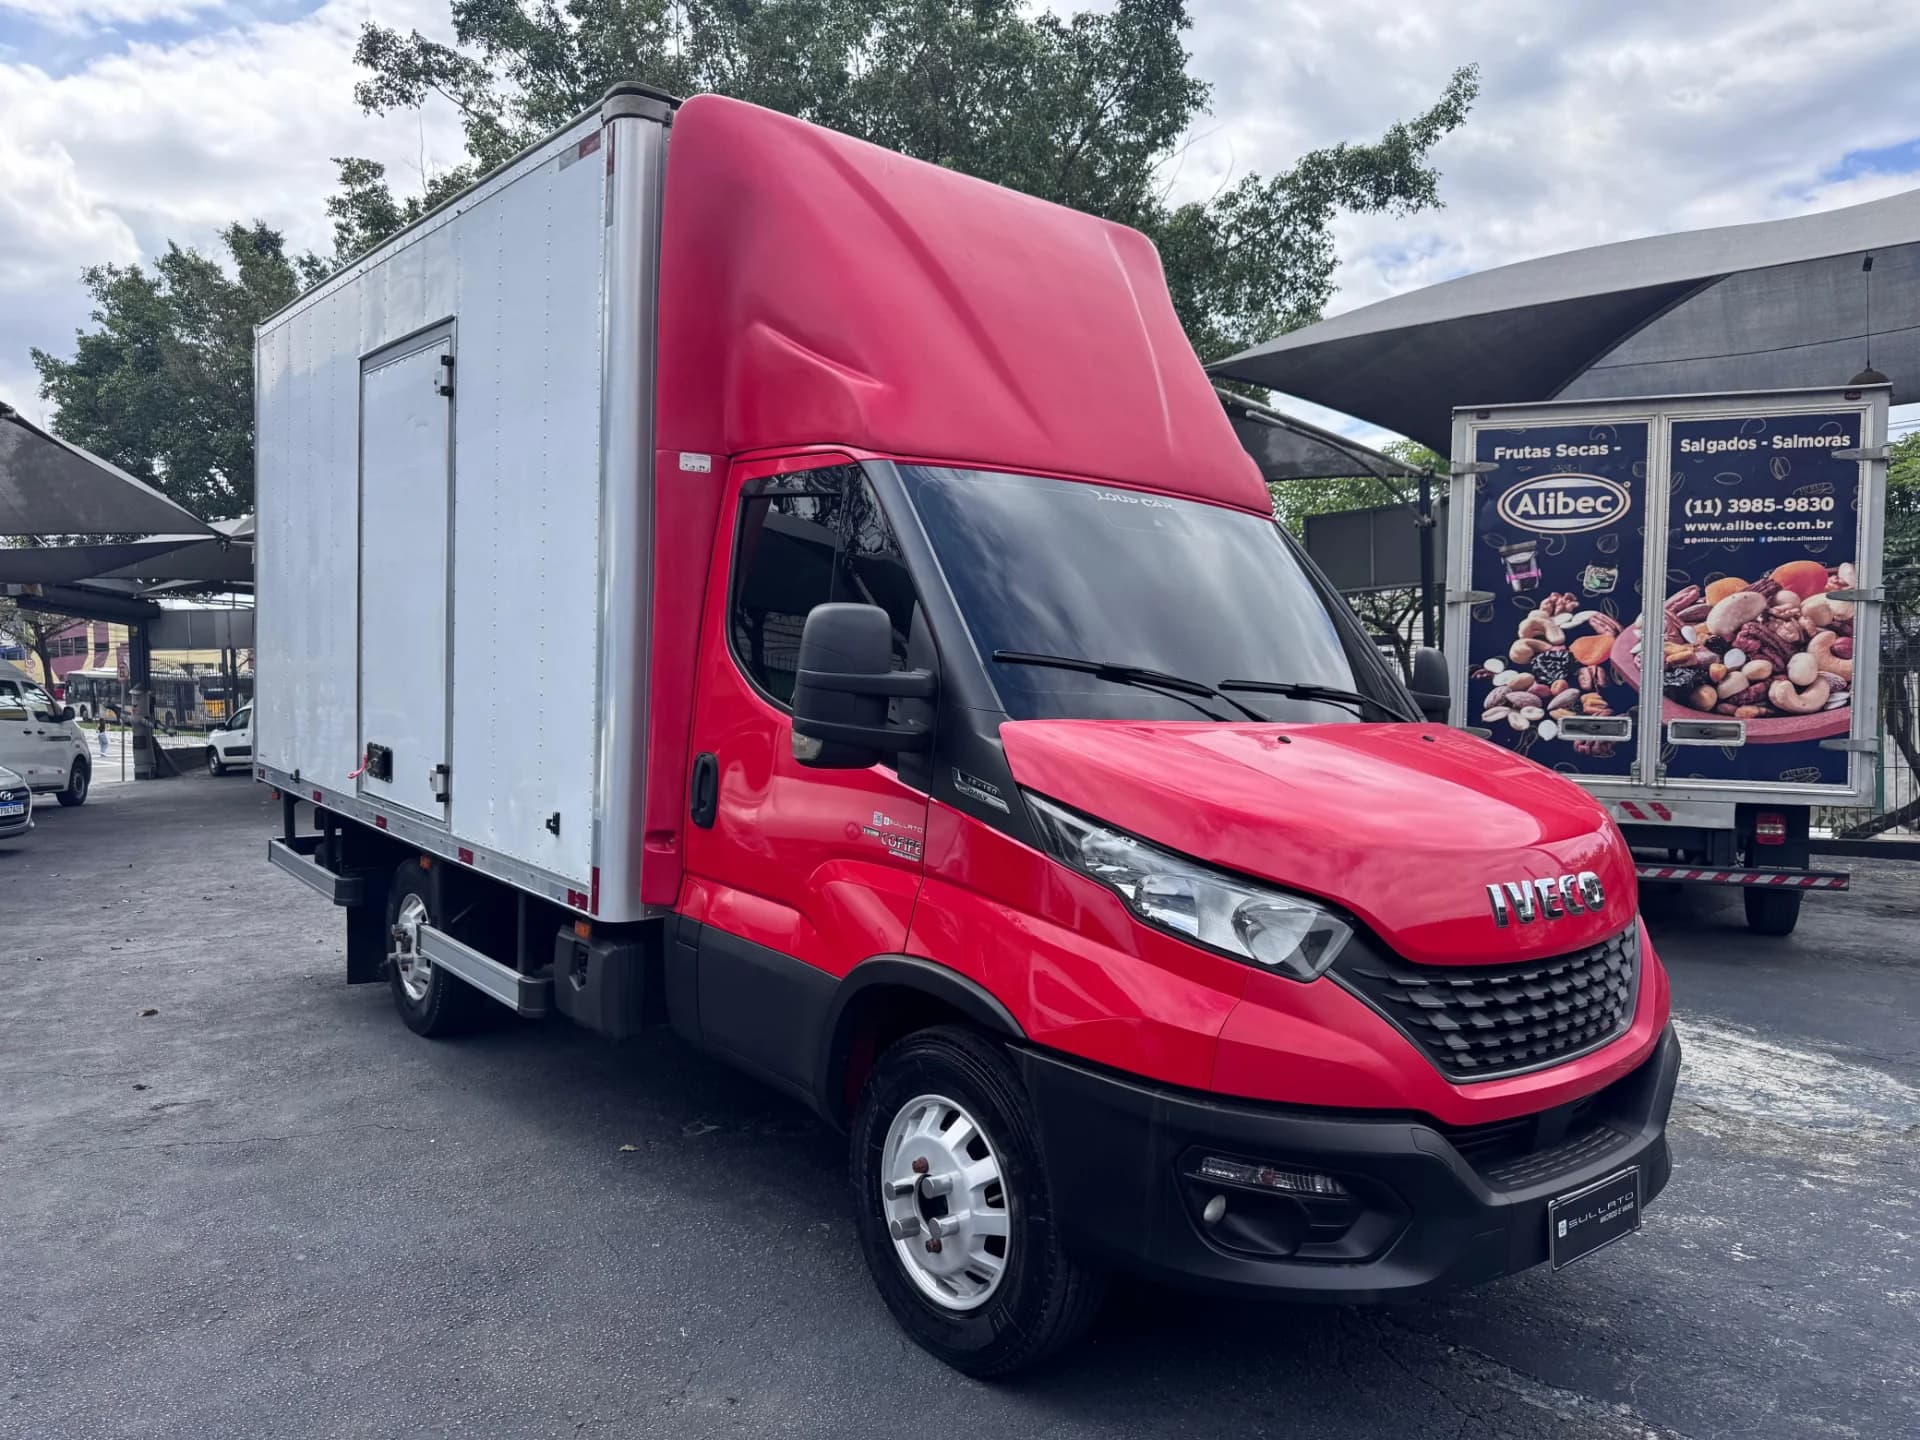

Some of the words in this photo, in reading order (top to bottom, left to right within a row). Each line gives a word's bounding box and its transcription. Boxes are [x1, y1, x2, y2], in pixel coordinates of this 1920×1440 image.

[1494, 446, 1551, 460] Frutas
[1556, 443, 1609, 457] Secas
[1680, 437, 1757, 454] Salgados
[1772, 434, 1851, 449] Salmoras
[1515, 491, 1613, 515] Alibec
[1685, 498, 1722, 517] (11)
[1727, 496, 1834, 513] 3985-9830
[1685, 518, 1834, 532] www.alibec.com.br
[1485, 871, 1605, 929] IVECO
[1568, 1191, 1634, 1229] SULLATO
